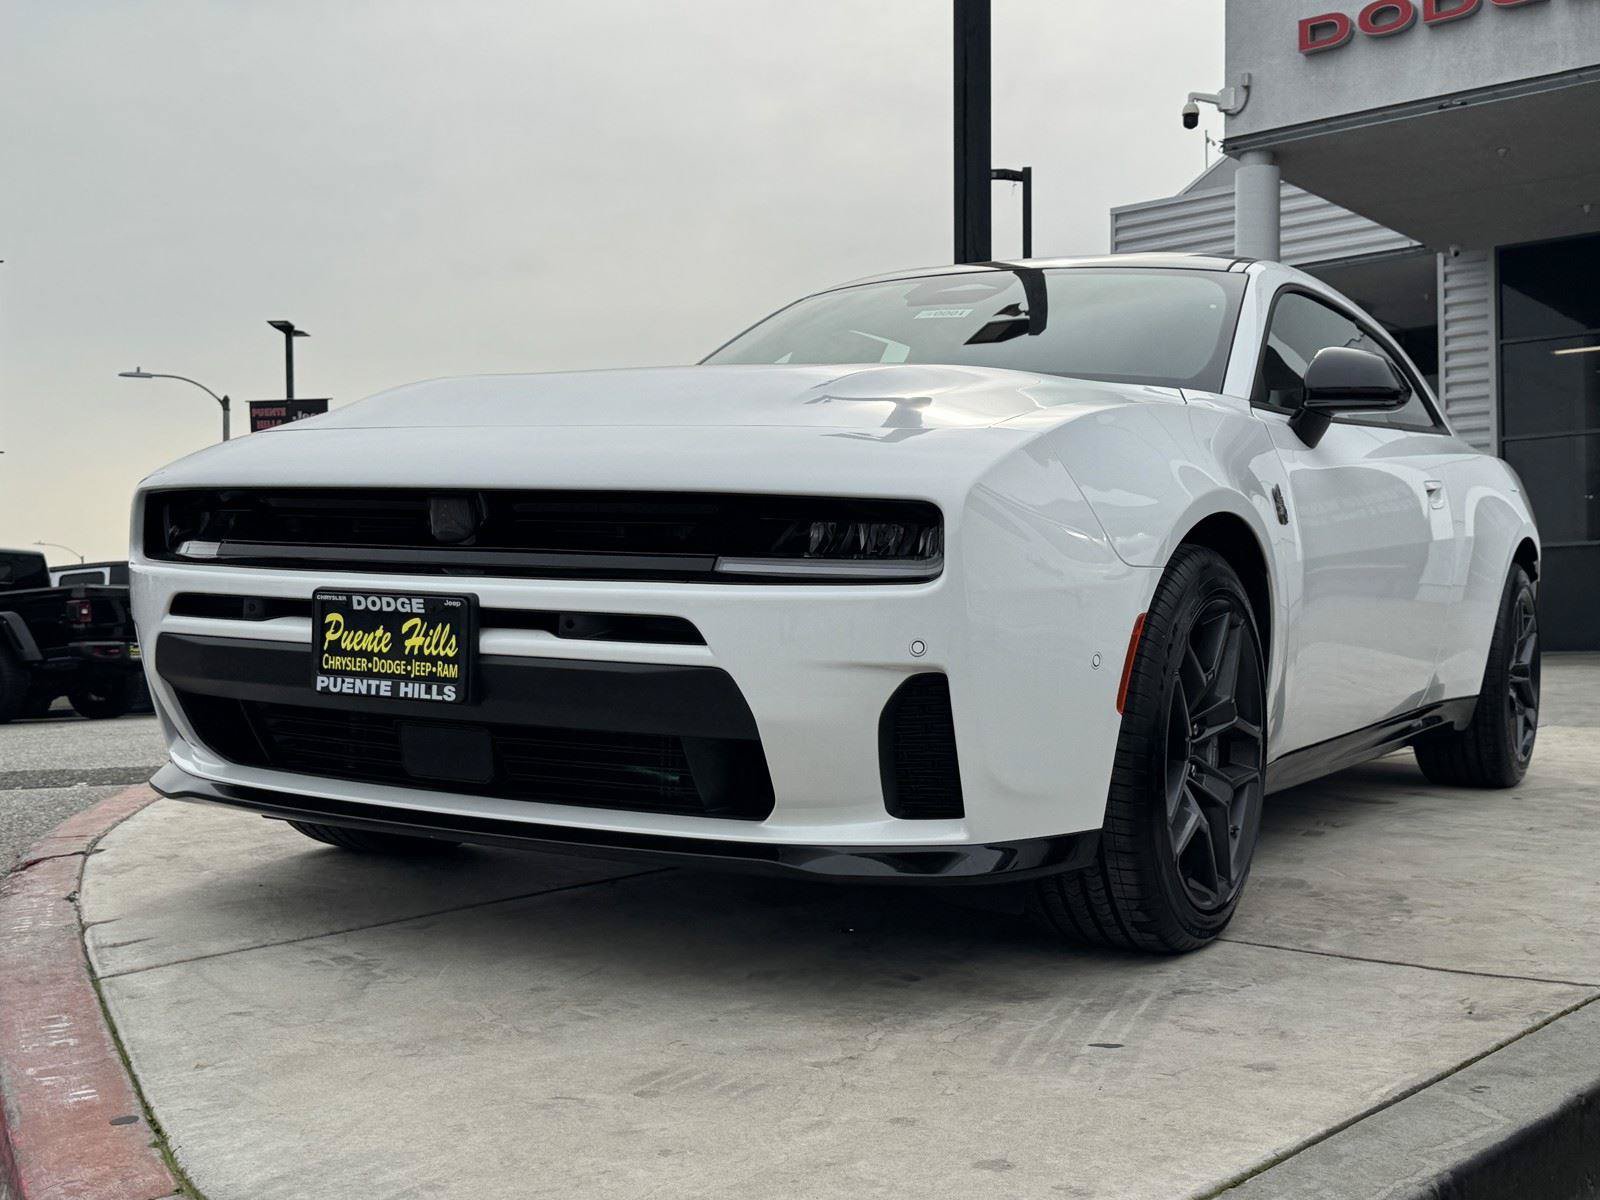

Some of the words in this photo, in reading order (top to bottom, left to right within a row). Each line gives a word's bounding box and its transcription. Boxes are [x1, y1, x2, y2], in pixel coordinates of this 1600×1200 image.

[1298, 0, 1552, 54] DOD
[251, 407, 286, 417] PUENTE
[352, 595, 425, 614] DODGE
[443, 599, 462, 608] Jeep
[323, 612, 393, 654] Puente
[401, 617, 459, 658] Hills
[316, 676, 392, 696] PUENTE
[400, 682, 457, 701] HILLS
